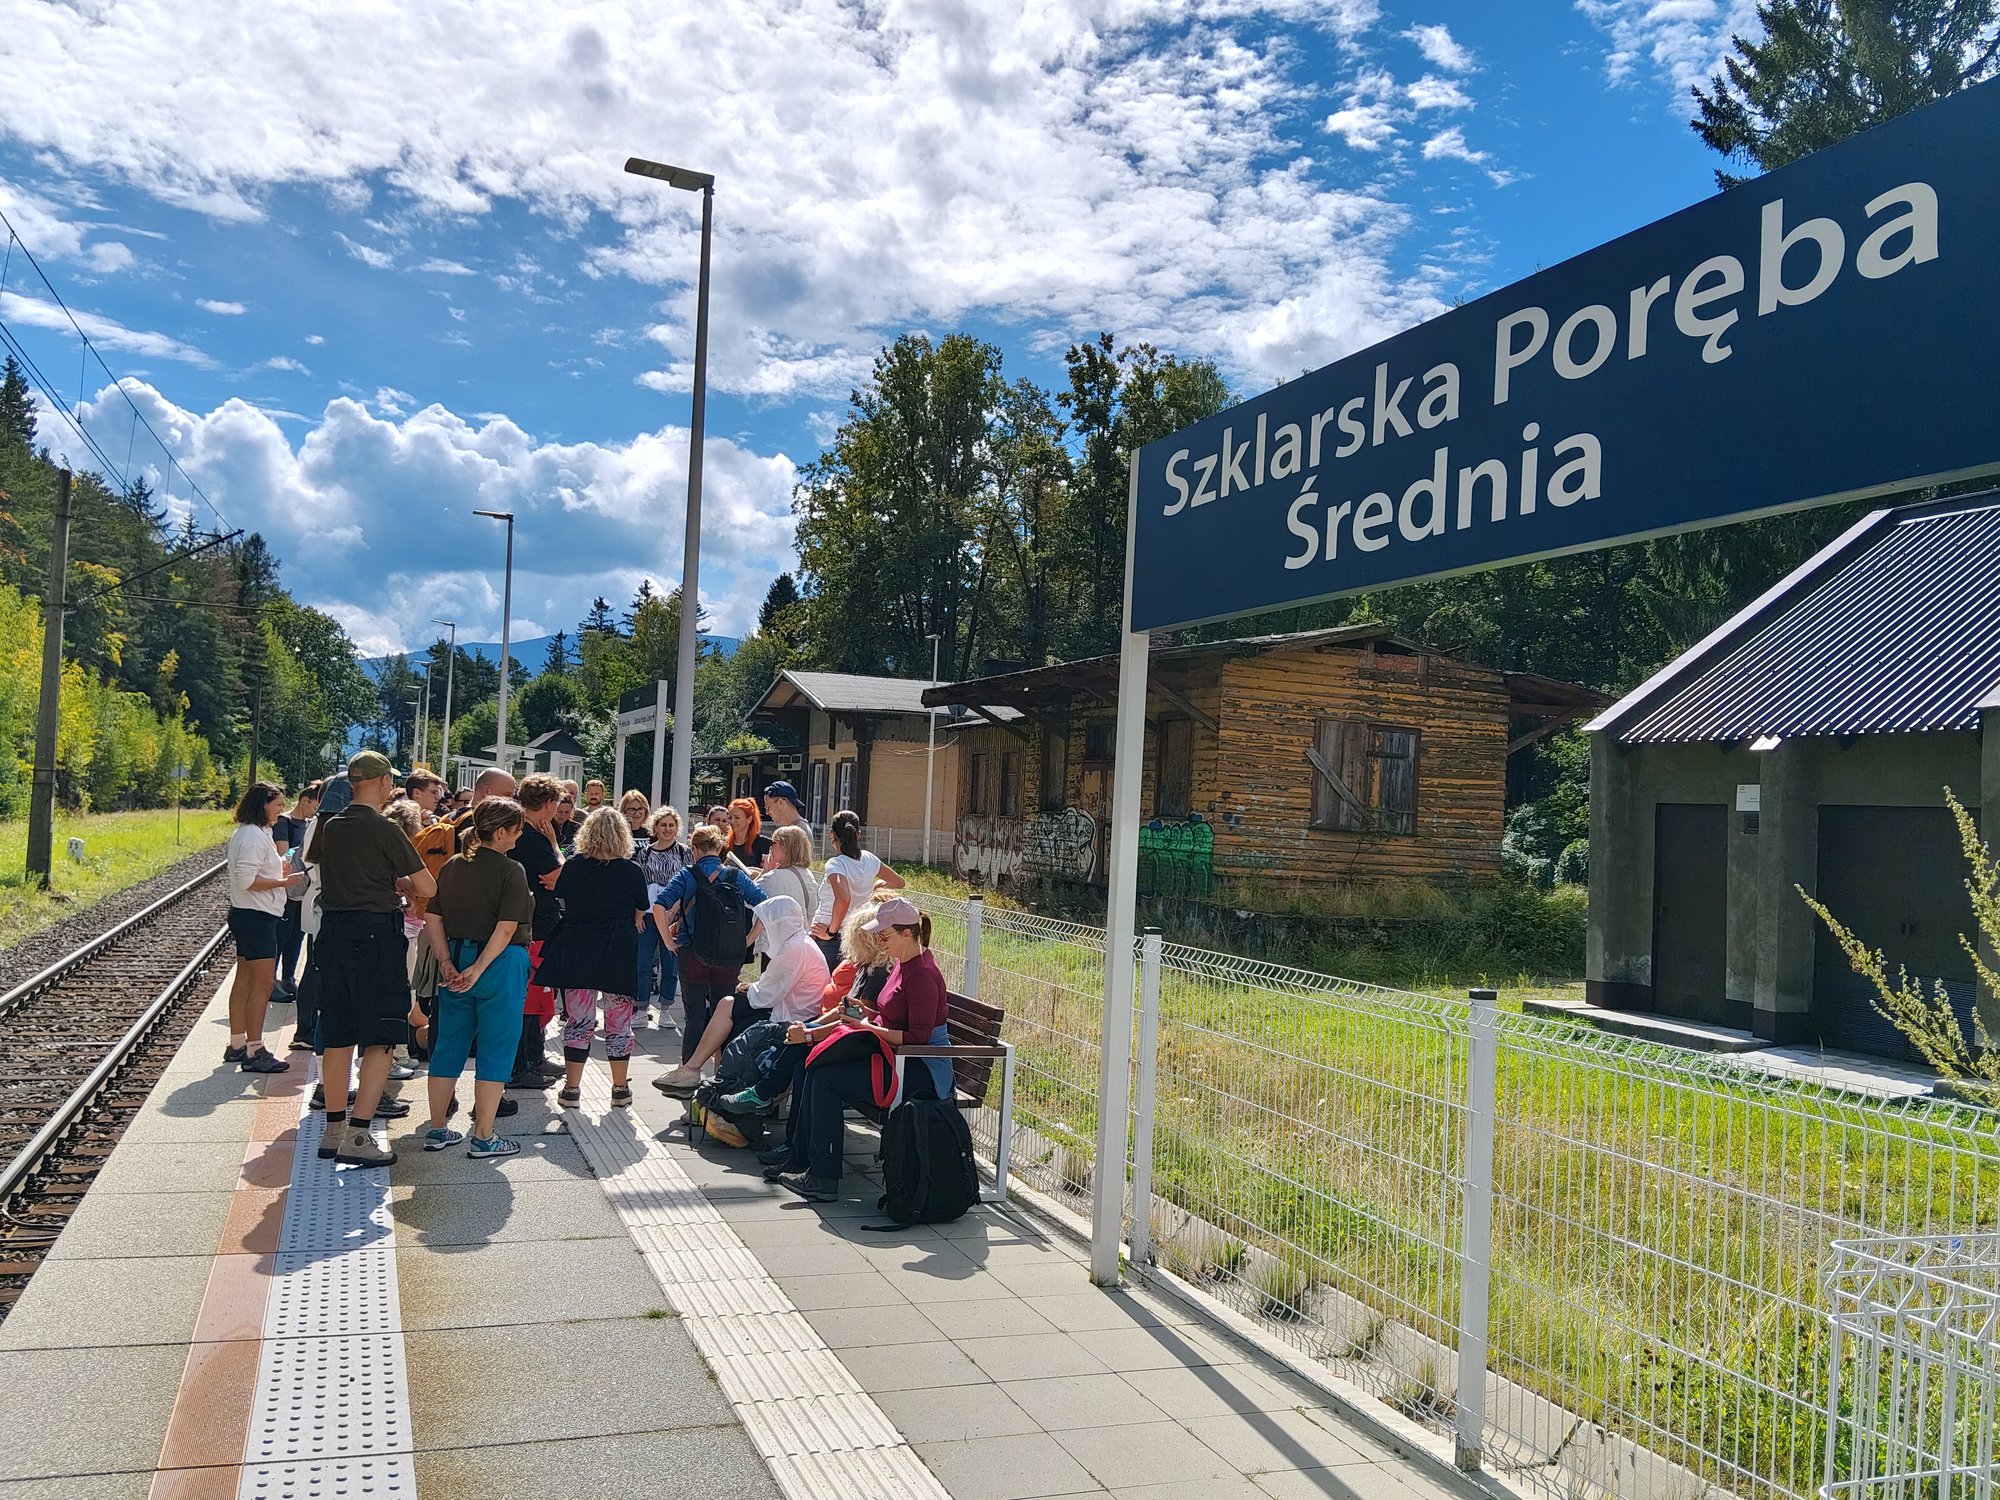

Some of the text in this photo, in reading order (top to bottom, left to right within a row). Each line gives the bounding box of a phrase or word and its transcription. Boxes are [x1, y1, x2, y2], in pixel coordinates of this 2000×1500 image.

[1163, 182, 1939, 516] Szklarska Poręba
[1285, 422, 1602, 570] Średnia
